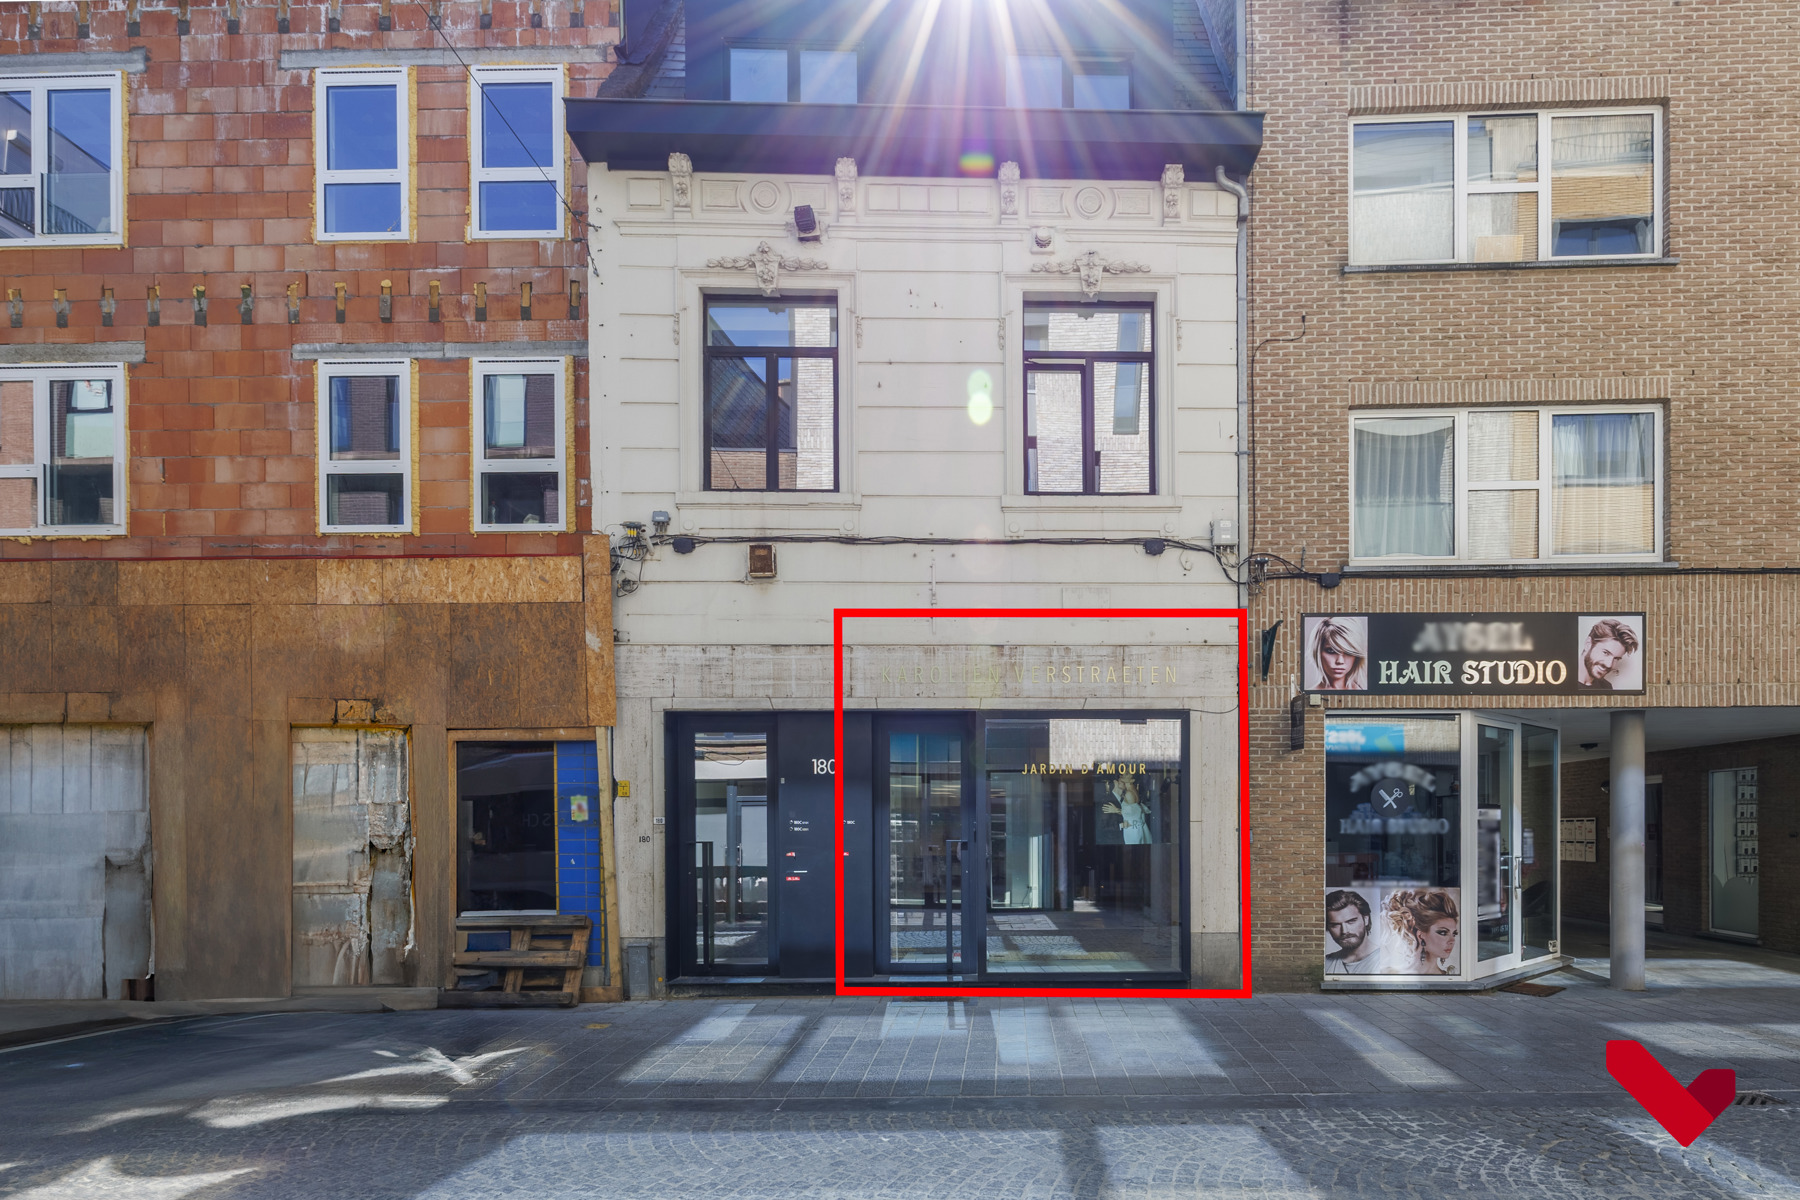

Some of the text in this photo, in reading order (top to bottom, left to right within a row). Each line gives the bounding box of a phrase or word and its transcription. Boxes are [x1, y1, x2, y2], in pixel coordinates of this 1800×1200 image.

[882, 665, 1177, 684] KAROLIEN VERSTRAETEN
[1378, 660, 1567, 685] HAIR STUDIO
[812, 758, 835, 775] 180
[1021, 763, 1147, 775] JARDIN D'AMOUR
[638, 835, 651, 843] 180
